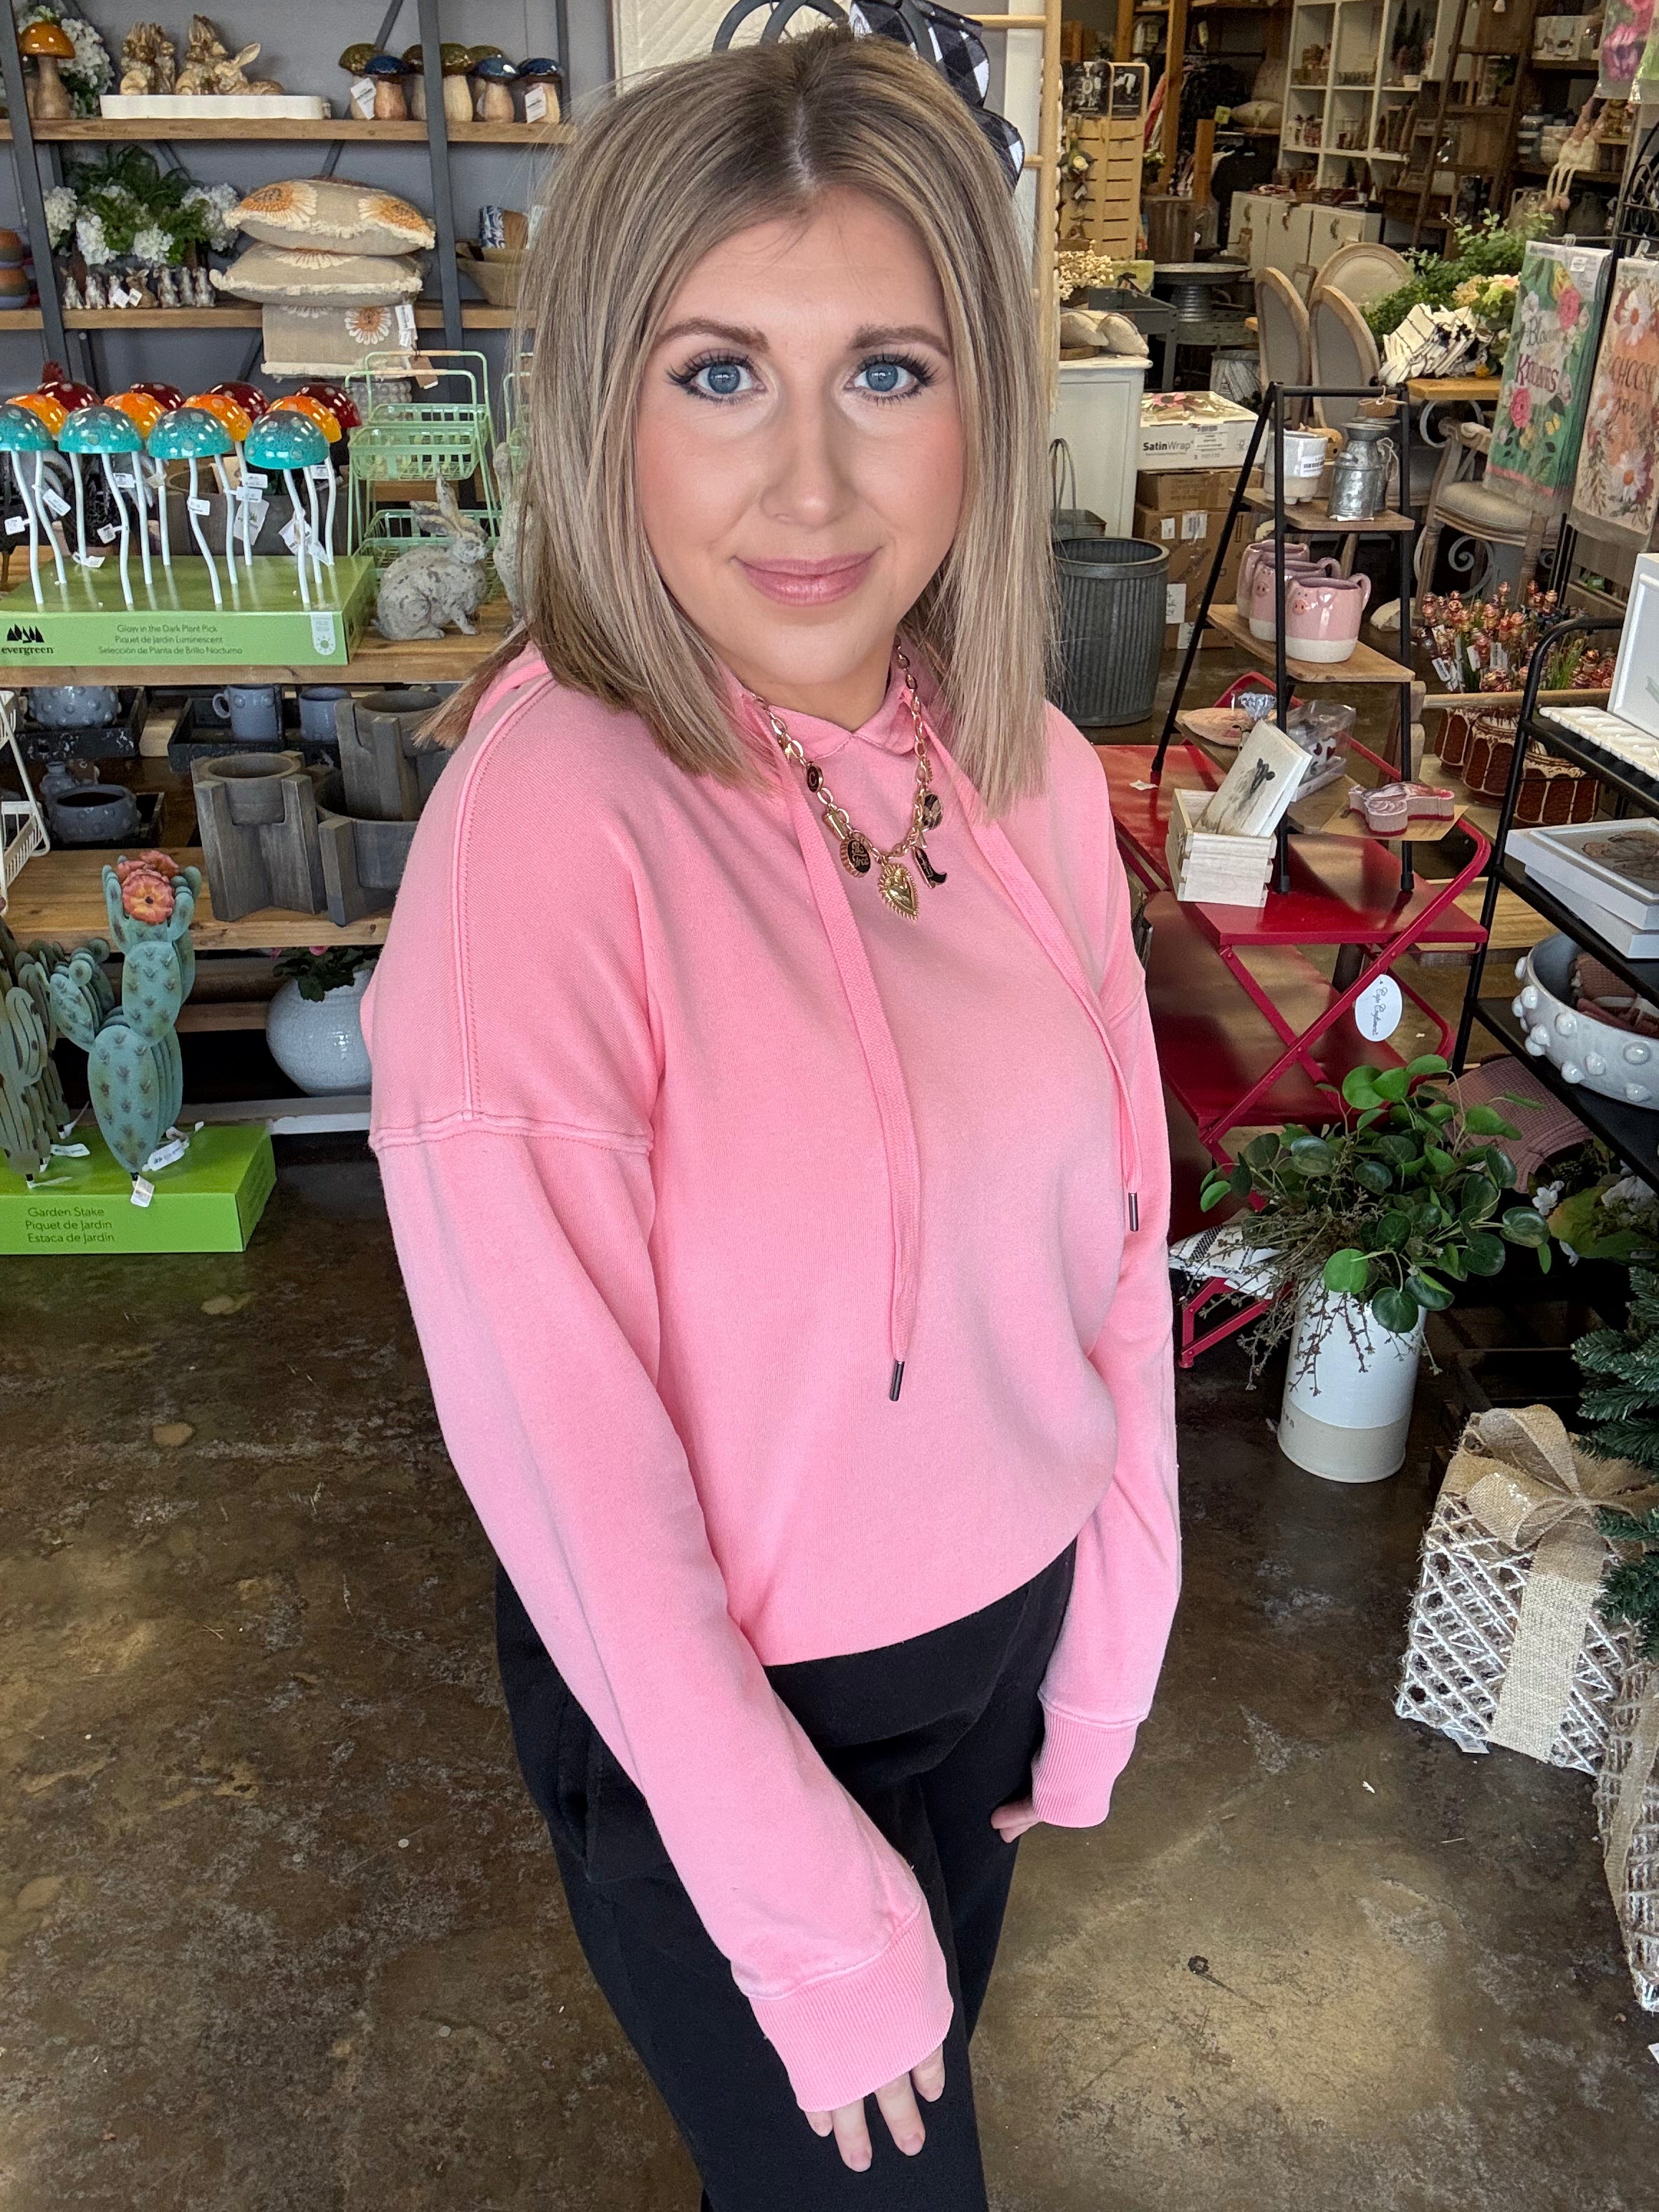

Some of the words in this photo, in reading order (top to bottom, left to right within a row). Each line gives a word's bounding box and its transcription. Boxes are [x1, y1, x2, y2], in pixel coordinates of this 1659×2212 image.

[117, 624, 138, 633] Glow
[140, 624, 148, 633] in
[148, 624, 161, 633] the
[163, 624, 181, 633] Dark
[182, 624, 201, 633] Plant
[202, 624, 218, 633] Pick
[115, 635, 140, 645] Piquet
[153, 635, 175, 645] Jardin
[175, 635, 223, 644] Luminescent
[1, 647, 54, 655] evergreen
[98, 646, 137, 655] Selección
[138, 646, 148, 655] de
[149, 646, 173, 655] Planta
[173, 646, 184, 655] de
[186, 646, 205, 655] Brillo
[206, 646, 243, 655] Nocturno
[28, 1206, 72, 1217] Garden
[73, 1206, 105, 1217] Stake
[25, 1221, 61, 1231] Piquet
[63, 1221, 78, 1230] de
[81, 1220, 112, 1231] Jardin
[27, 1233, 64, 1243] Estaca
[66, 1233, 81, 1243] de
